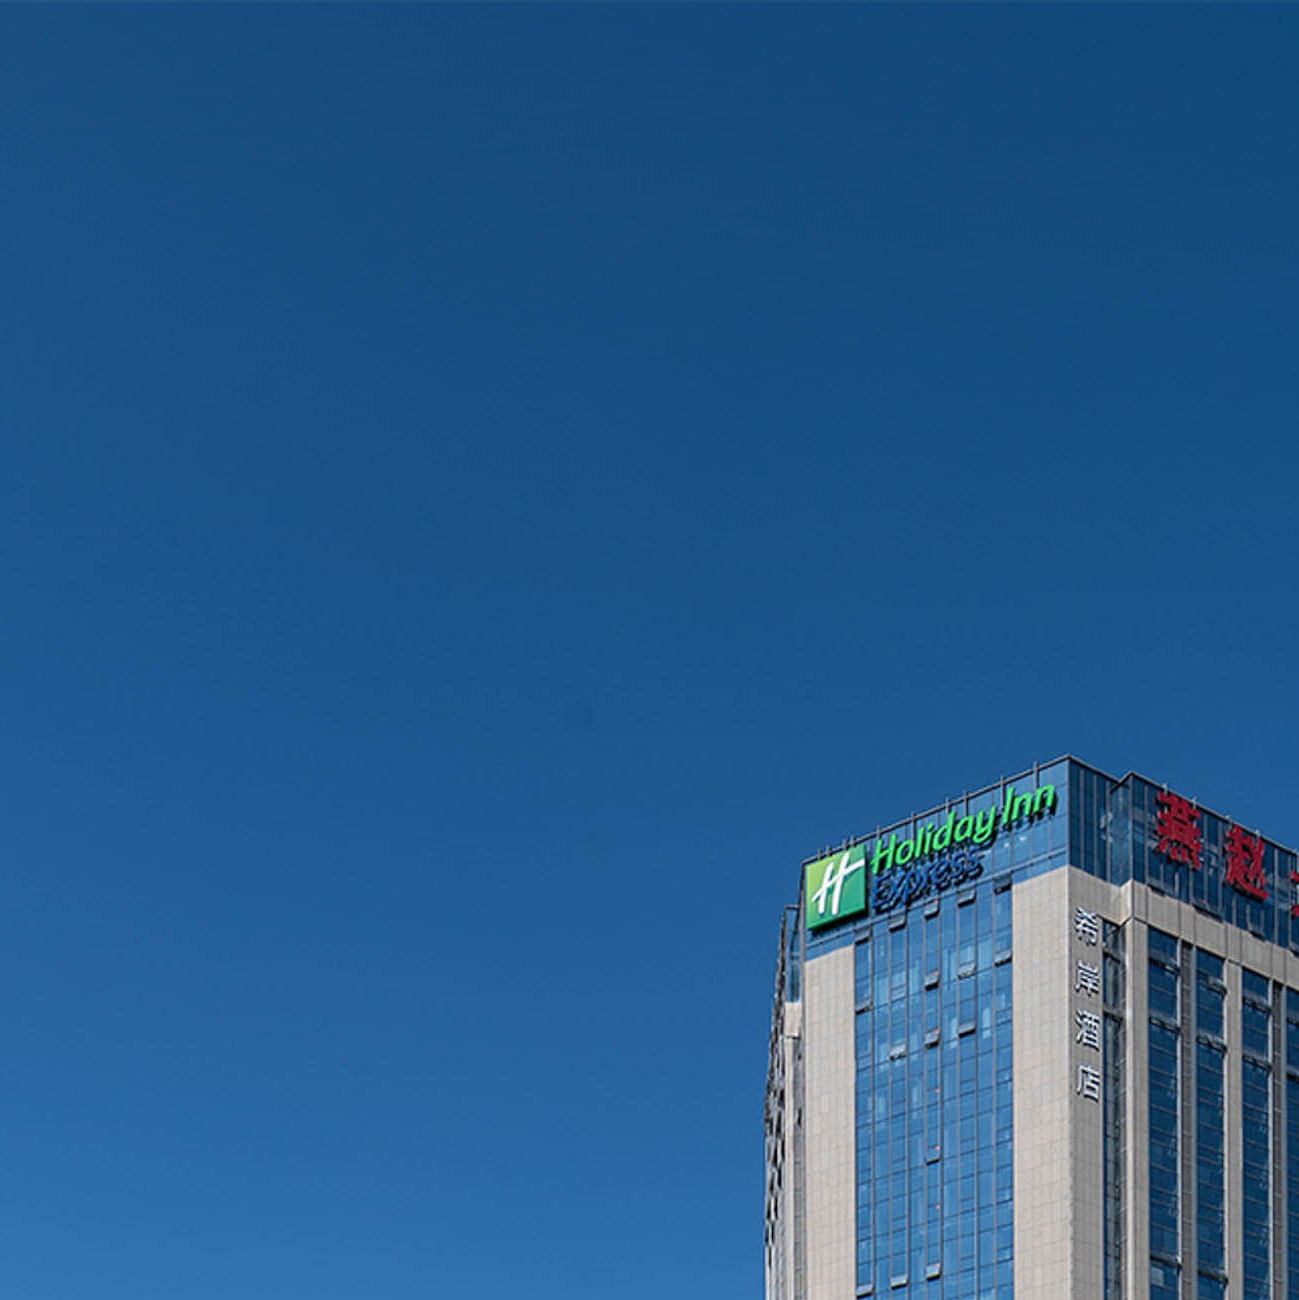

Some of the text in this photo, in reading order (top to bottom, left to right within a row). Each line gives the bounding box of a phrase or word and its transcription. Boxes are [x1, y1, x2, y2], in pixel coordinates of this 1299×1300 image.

[870, 783, 1055, 875] Holiday Inn
[872, 847, 982, 909] Express
[1073, 905, 1101, 1104] 希岸酒店
